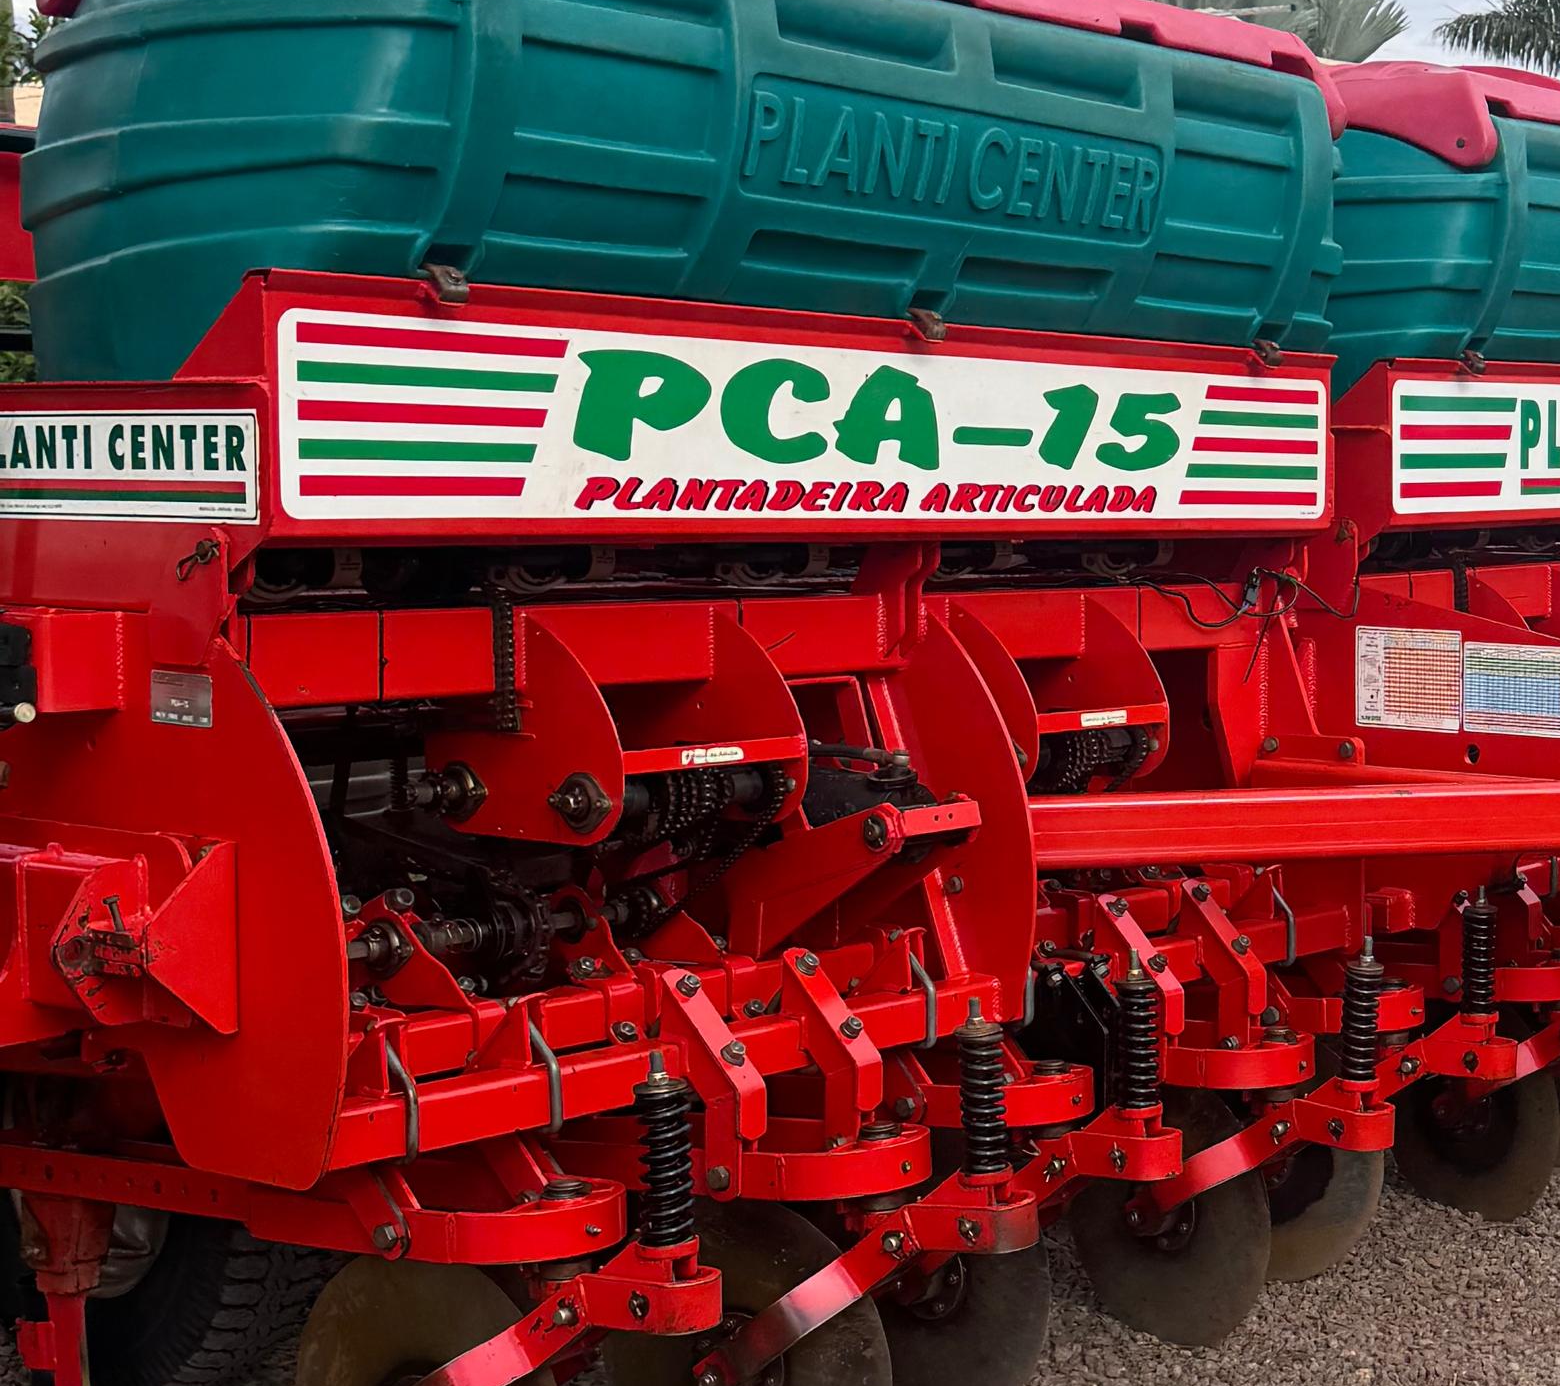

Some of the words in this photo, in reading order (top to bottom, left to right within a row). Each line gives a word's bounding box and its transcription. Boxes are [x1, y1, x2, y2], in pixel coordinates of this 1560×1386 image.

[743, 91, 959, 205] PLANTI
[970, 127, 1161, 233] CENTER
[0, 424, 92, 470] ANTI
[108, 424, 247, 471] CENTER
[573, 350, 1181, 470] PCA-15
[574, 476, 910, 513] PLANTADEIRA
[918, 478, 1157, 513] ARTICULADA
